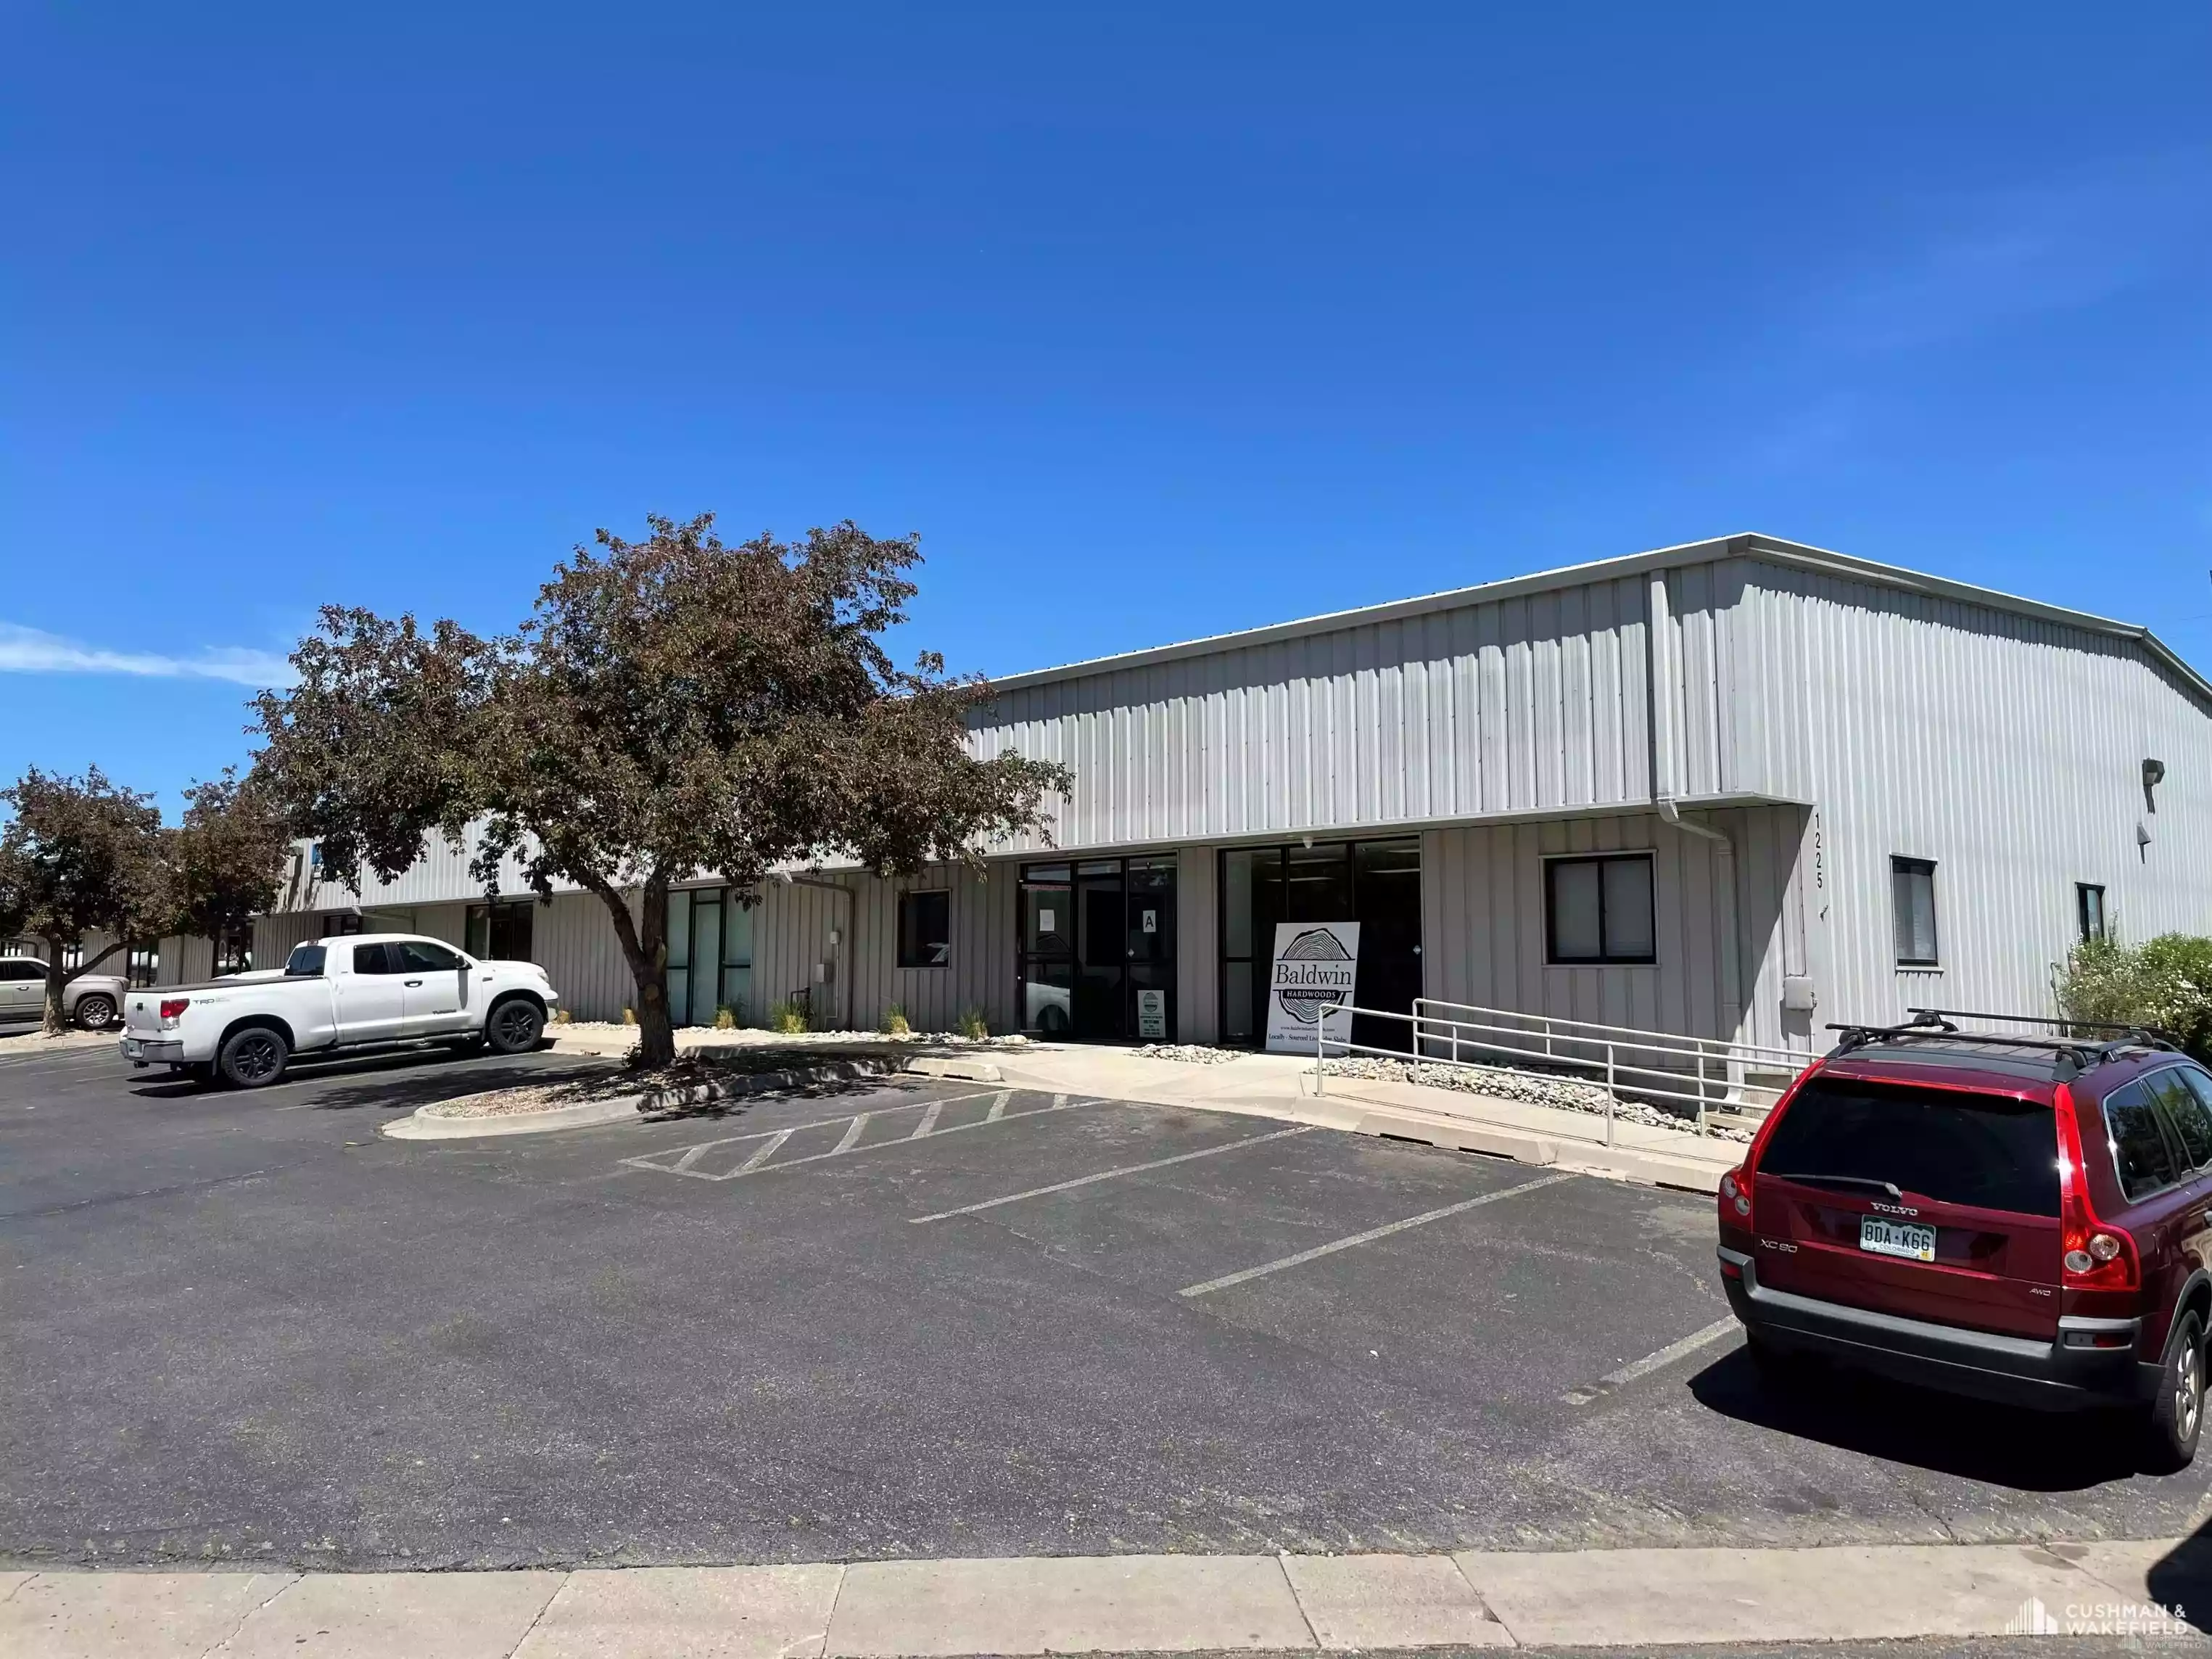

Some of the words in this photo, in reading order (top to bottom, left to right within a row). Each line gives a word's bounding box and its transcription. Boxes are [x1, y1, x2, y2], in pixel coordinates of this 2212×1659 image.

[1145, 915, 1154, 928] A
[1274, 963, 1352, 985] Baldwin
[1870, 1201, 1918, 1216] VOLVO
[1880, 1244, 1915, 1255] COLORADO
